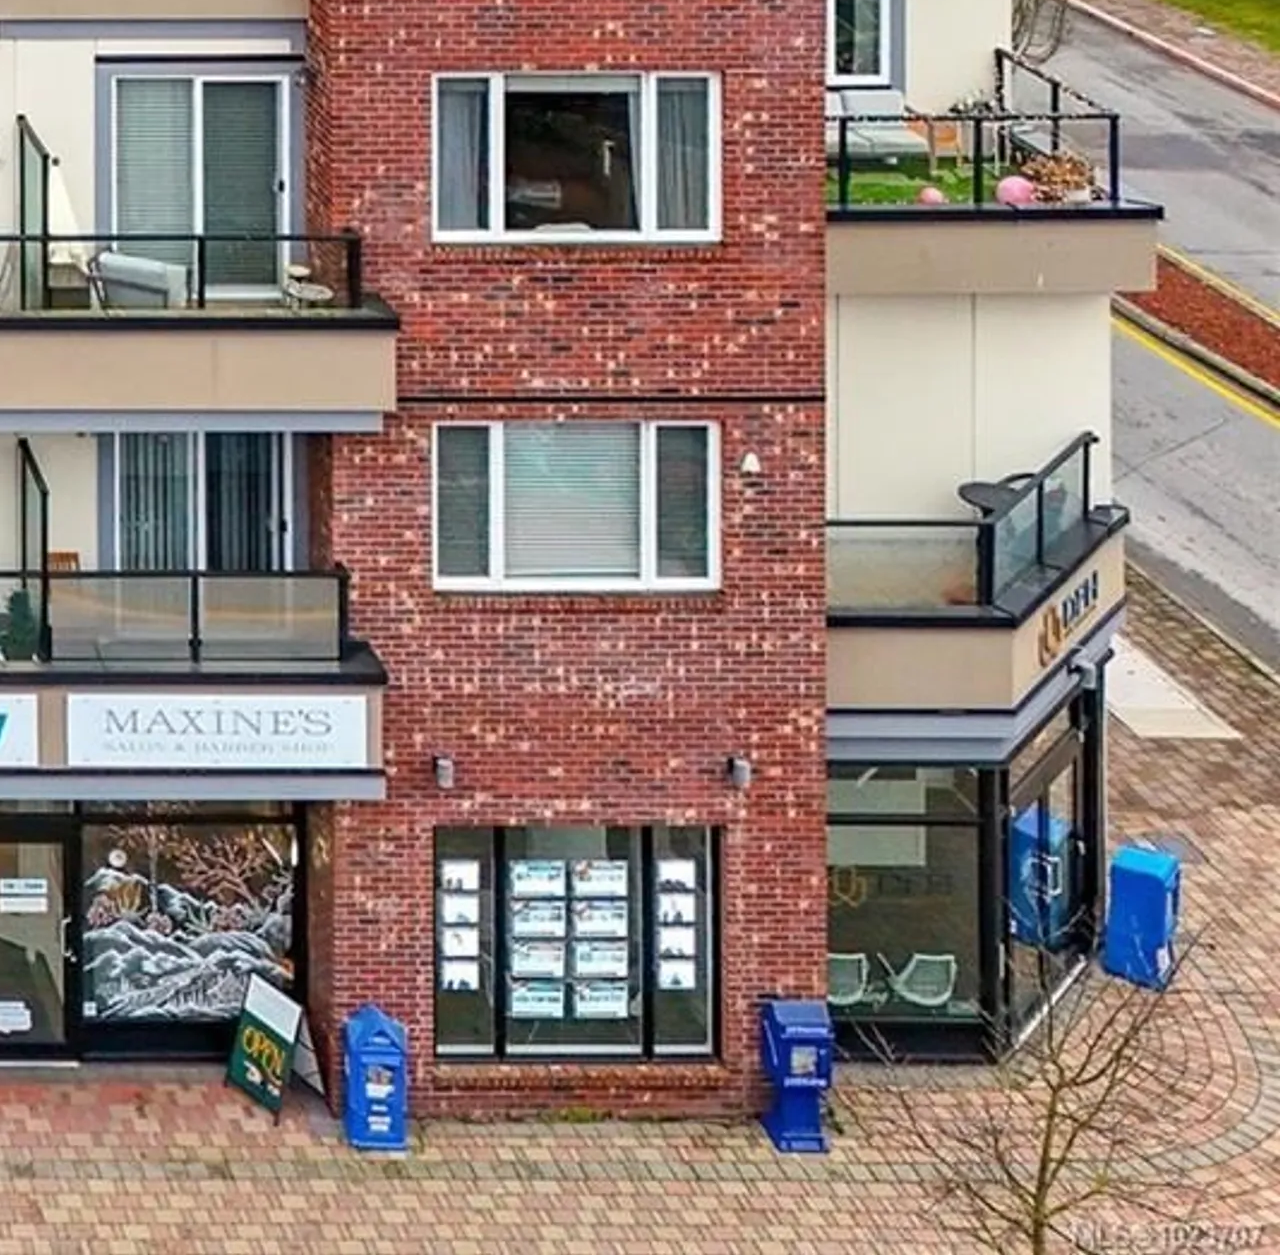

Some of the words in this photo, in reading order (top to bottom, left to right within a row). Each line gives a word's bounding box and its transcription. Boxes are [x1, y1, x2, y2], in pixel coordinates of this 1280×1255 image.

[1062, 570, 1098, 629] DFH
[105, 708, 333, 737] MAXINE'S
[243, 1026, 286, 1076] OPEN
